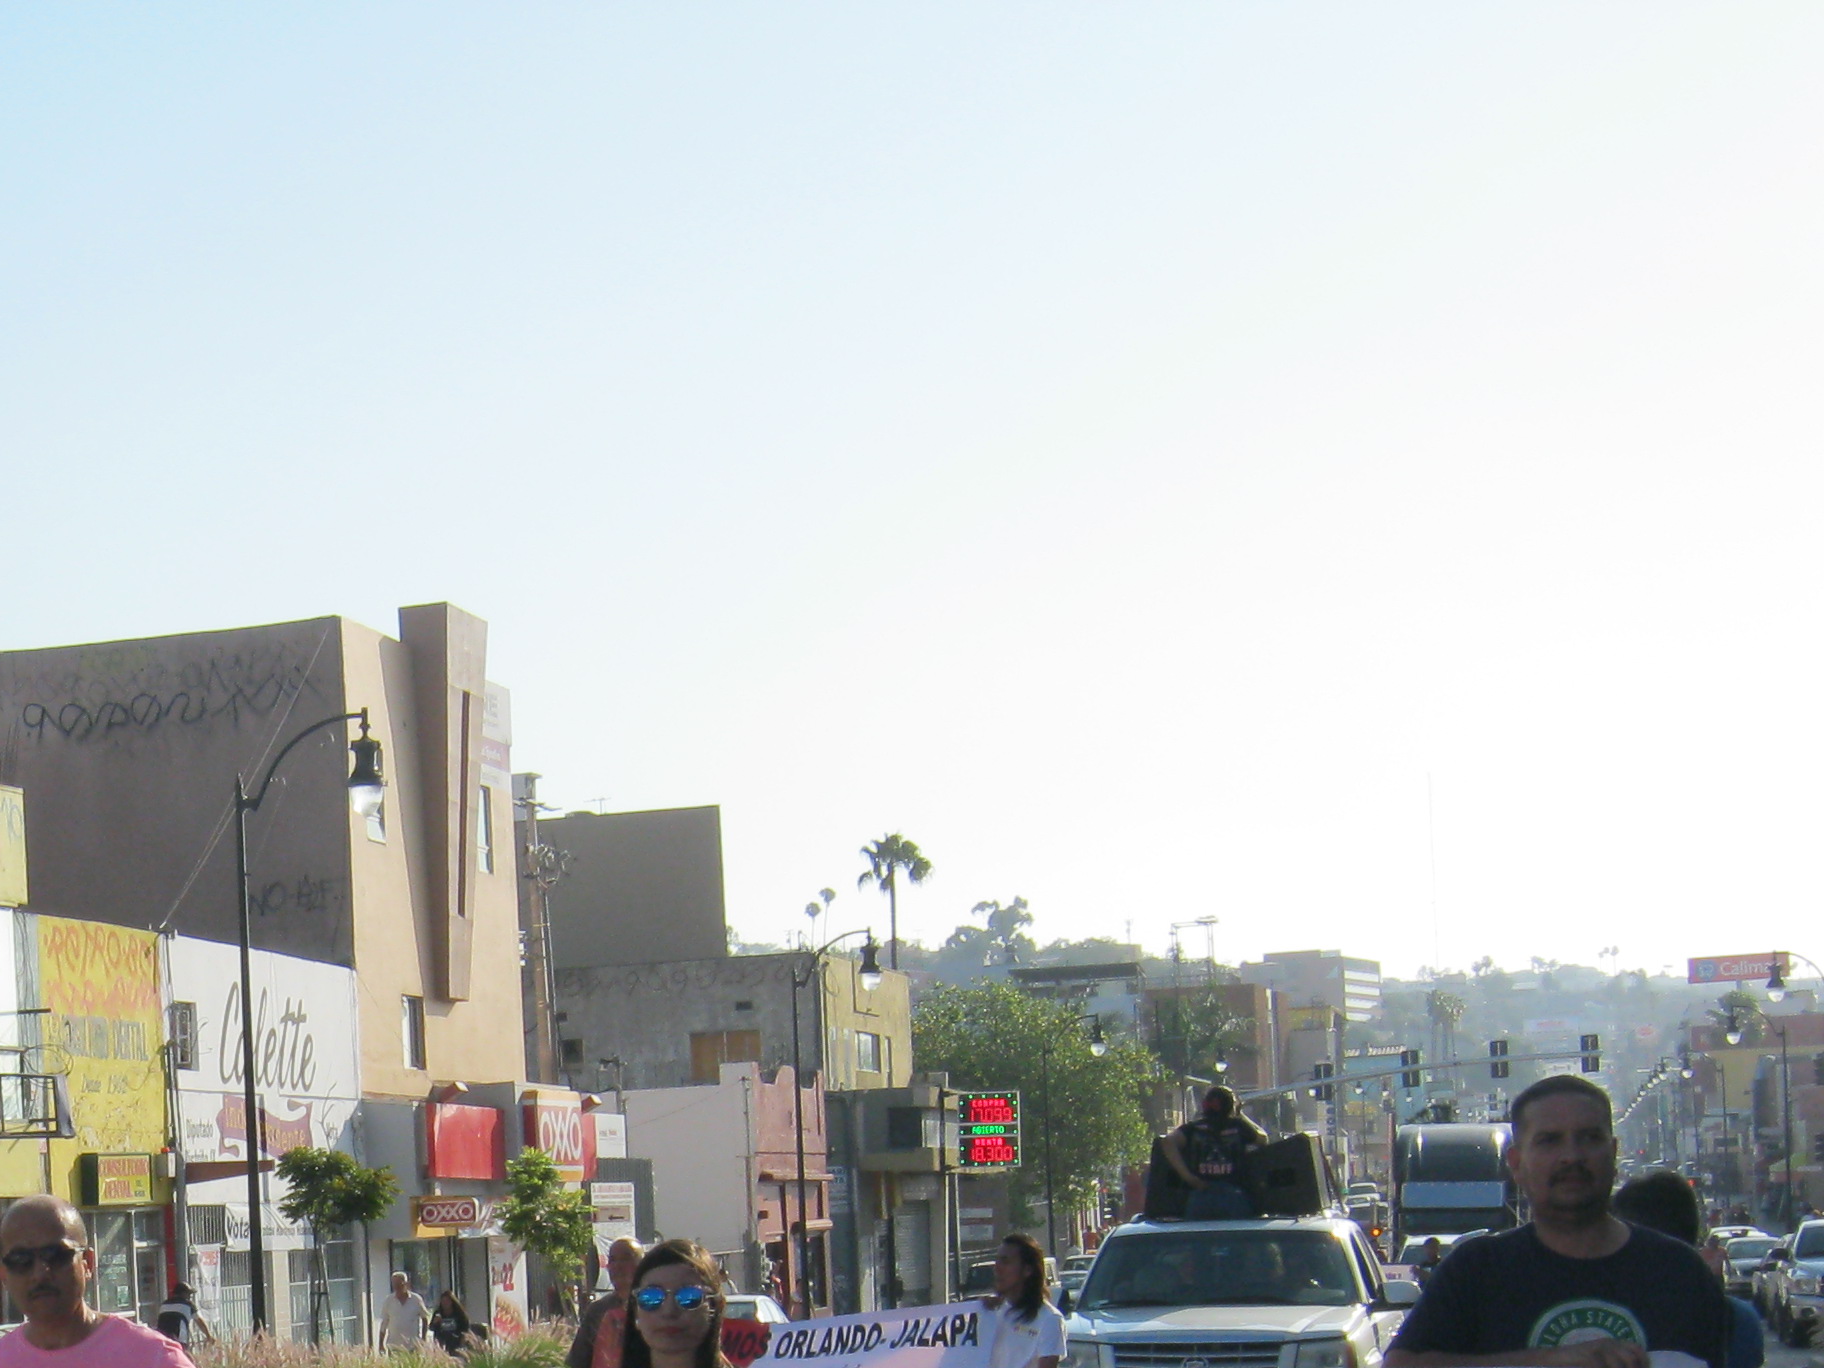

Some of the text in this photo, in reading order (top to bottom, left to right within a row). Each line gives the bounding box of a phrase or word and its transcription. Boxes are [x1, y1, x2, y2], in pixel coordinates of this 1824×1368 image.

[1720, 961, 1782, 976] Calima
[539, 1108, 583, 1162] OXXO
[422, 1205, 475, 1224] OXXO
[890, 1312, 978, 1349] JALAPA
[1537, 1311, 1579, 1348] LOHA
